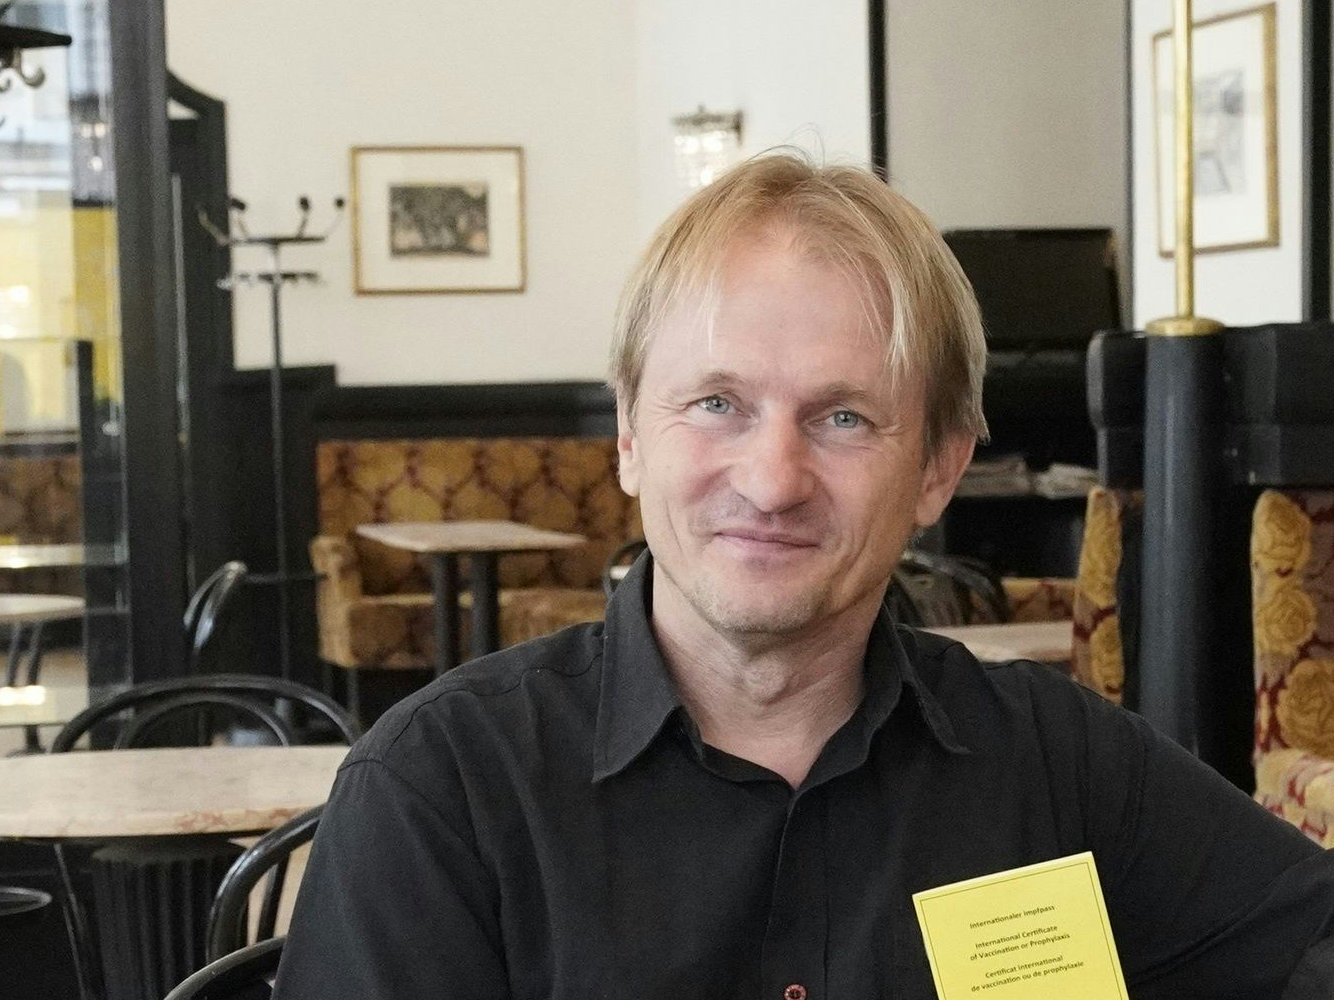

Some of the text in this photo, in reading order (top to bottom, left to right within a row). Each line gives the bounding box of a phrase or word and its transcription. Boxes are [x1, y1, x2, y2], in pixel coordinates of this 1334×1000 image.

[969, 905, 1055, 929] Internationaler Impfpass
[970, 953, 977, 961] of
[978, 944, 1019, 959] Vaccination
[1029, 933, 1070, 947] Prophylaxis
[975, 925, 1058, 949] International Certificate
[981, 975, 1021, 990] vaccination
[1043, 961, 1084, 976] prophylaxie
[985, 955, 1063, 978] Certificat international
